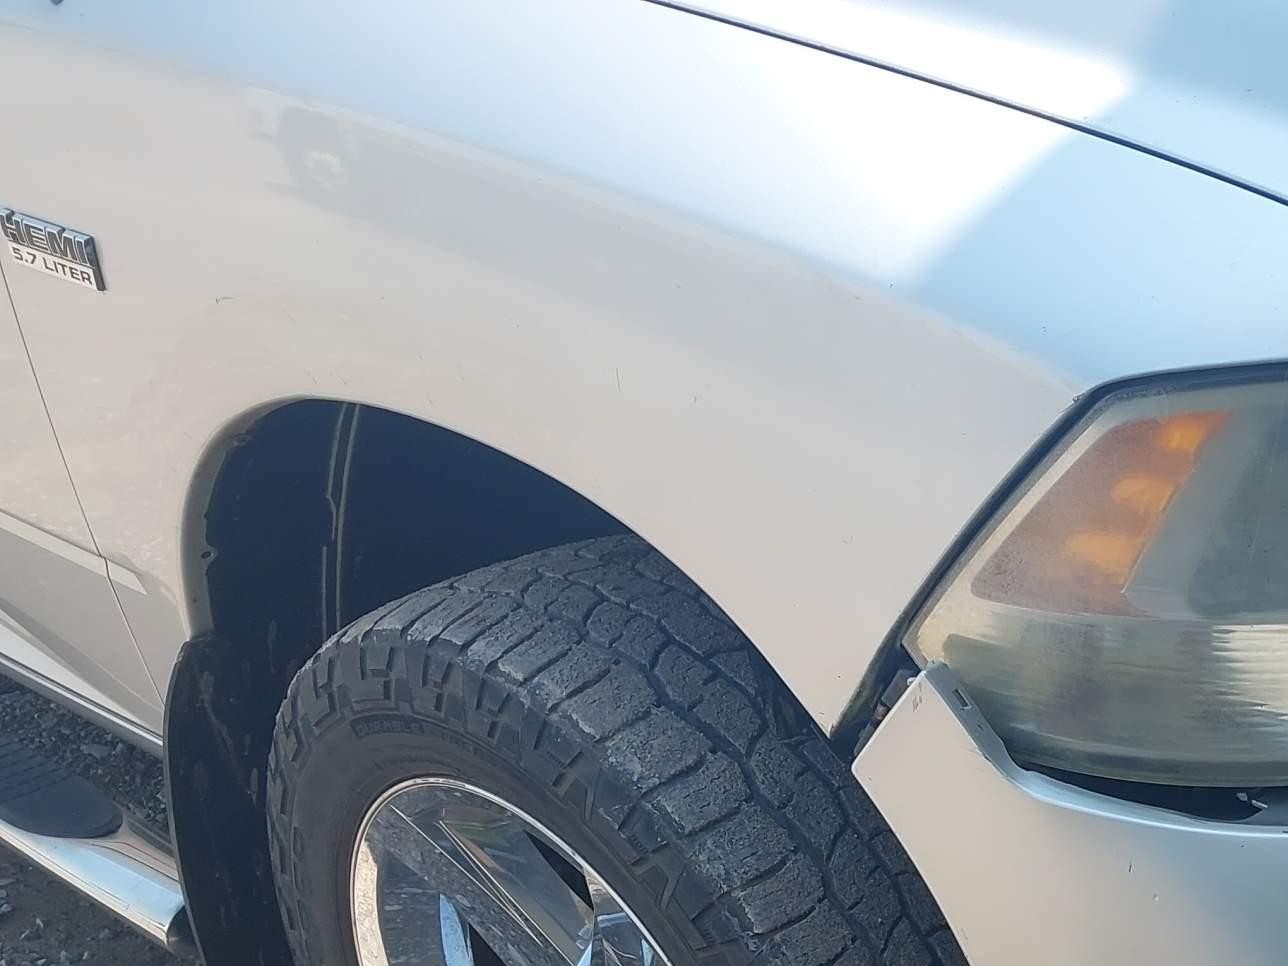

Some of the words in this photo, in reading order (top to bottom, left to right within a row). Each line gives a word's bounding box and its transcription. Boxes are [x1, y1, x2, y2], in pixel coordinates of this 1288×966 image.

[0, 208, 91, 267] HEMI
[11, 246, 37, 265] 5.7
[42, 256, 93, 286] LITER
